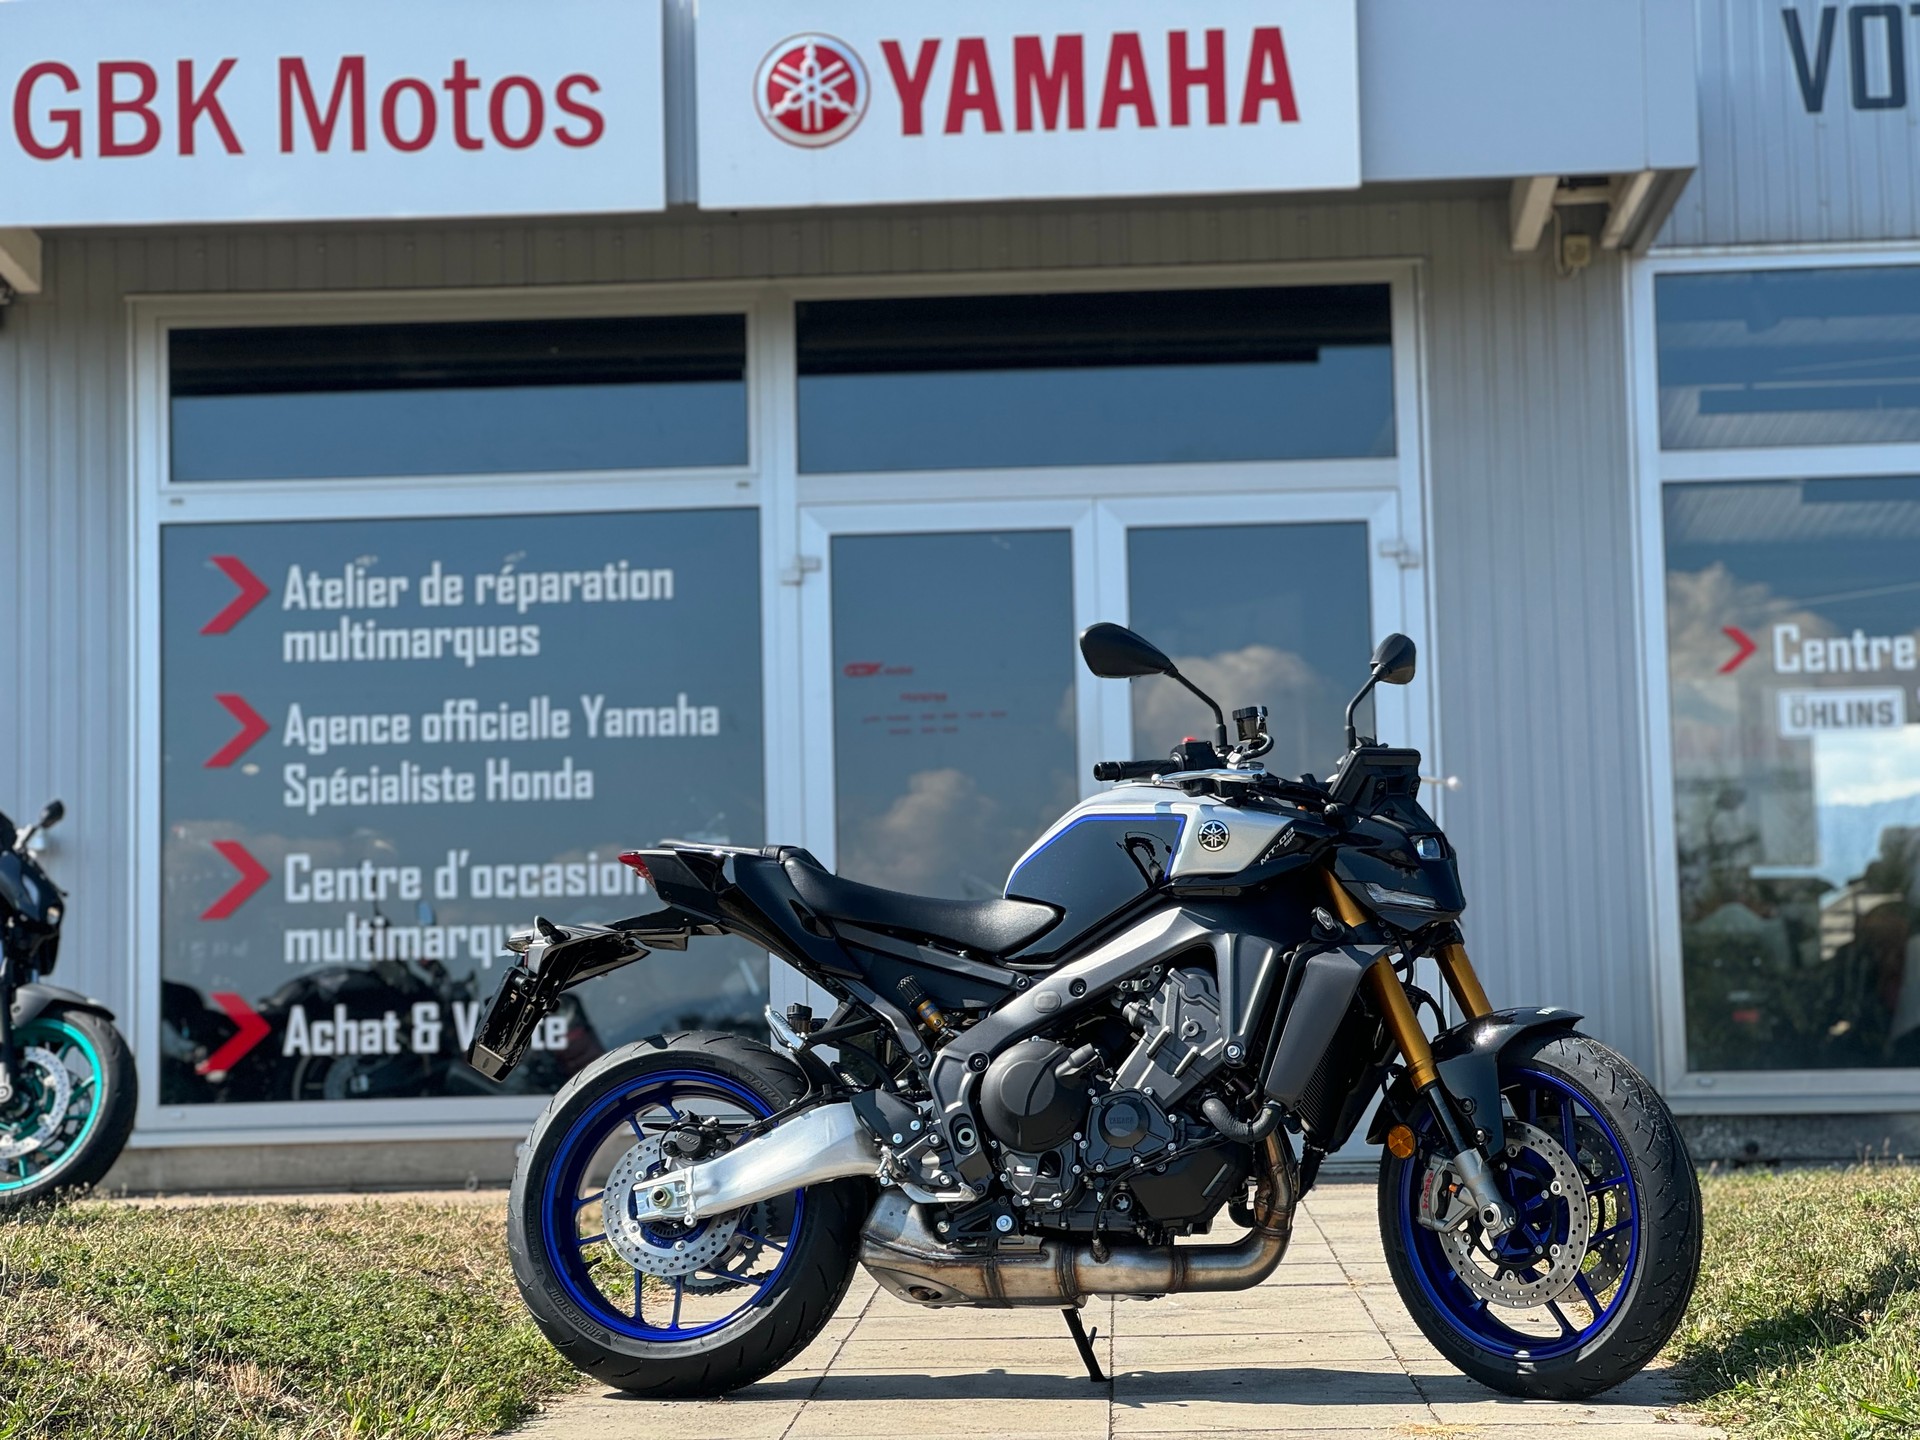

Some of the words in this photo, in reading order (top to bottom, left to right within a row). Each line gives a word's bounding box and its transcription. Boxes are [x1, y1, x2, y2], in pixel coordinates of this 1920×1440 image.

[12, 57, 244, 161] GBK
[278, 55, 606, 153] Motos
[879, 26, 1301, 137] YAMAHA
[282, 563, 408, 611] Atelier
[420, 561, 463, 607] de
[475, 560, 674, 614] réparation
[283, 616, 540, 668] multimarques
[1773, 623, 1917, 673] Centre
[283, 703, 411, 754] Agence
[421, 696, 571, 743] officielle
[581, 693, 720, 739] Yamaha
[283, 760, 476, 815] Spécialiste
[486, 757, 594, 802] Honda
[284, 853, 423, 903] Centre
[435, 849, 647, 899] d'occasion
[284, 911, 522, 970] multimarqu
[282, 1000, 401, 1057] Achat
[411, 1001, 442, 1055] &
[452, 1001, 569, 1052] Vte
[547, 1286, 605, 1340] BRIDGESTONE
